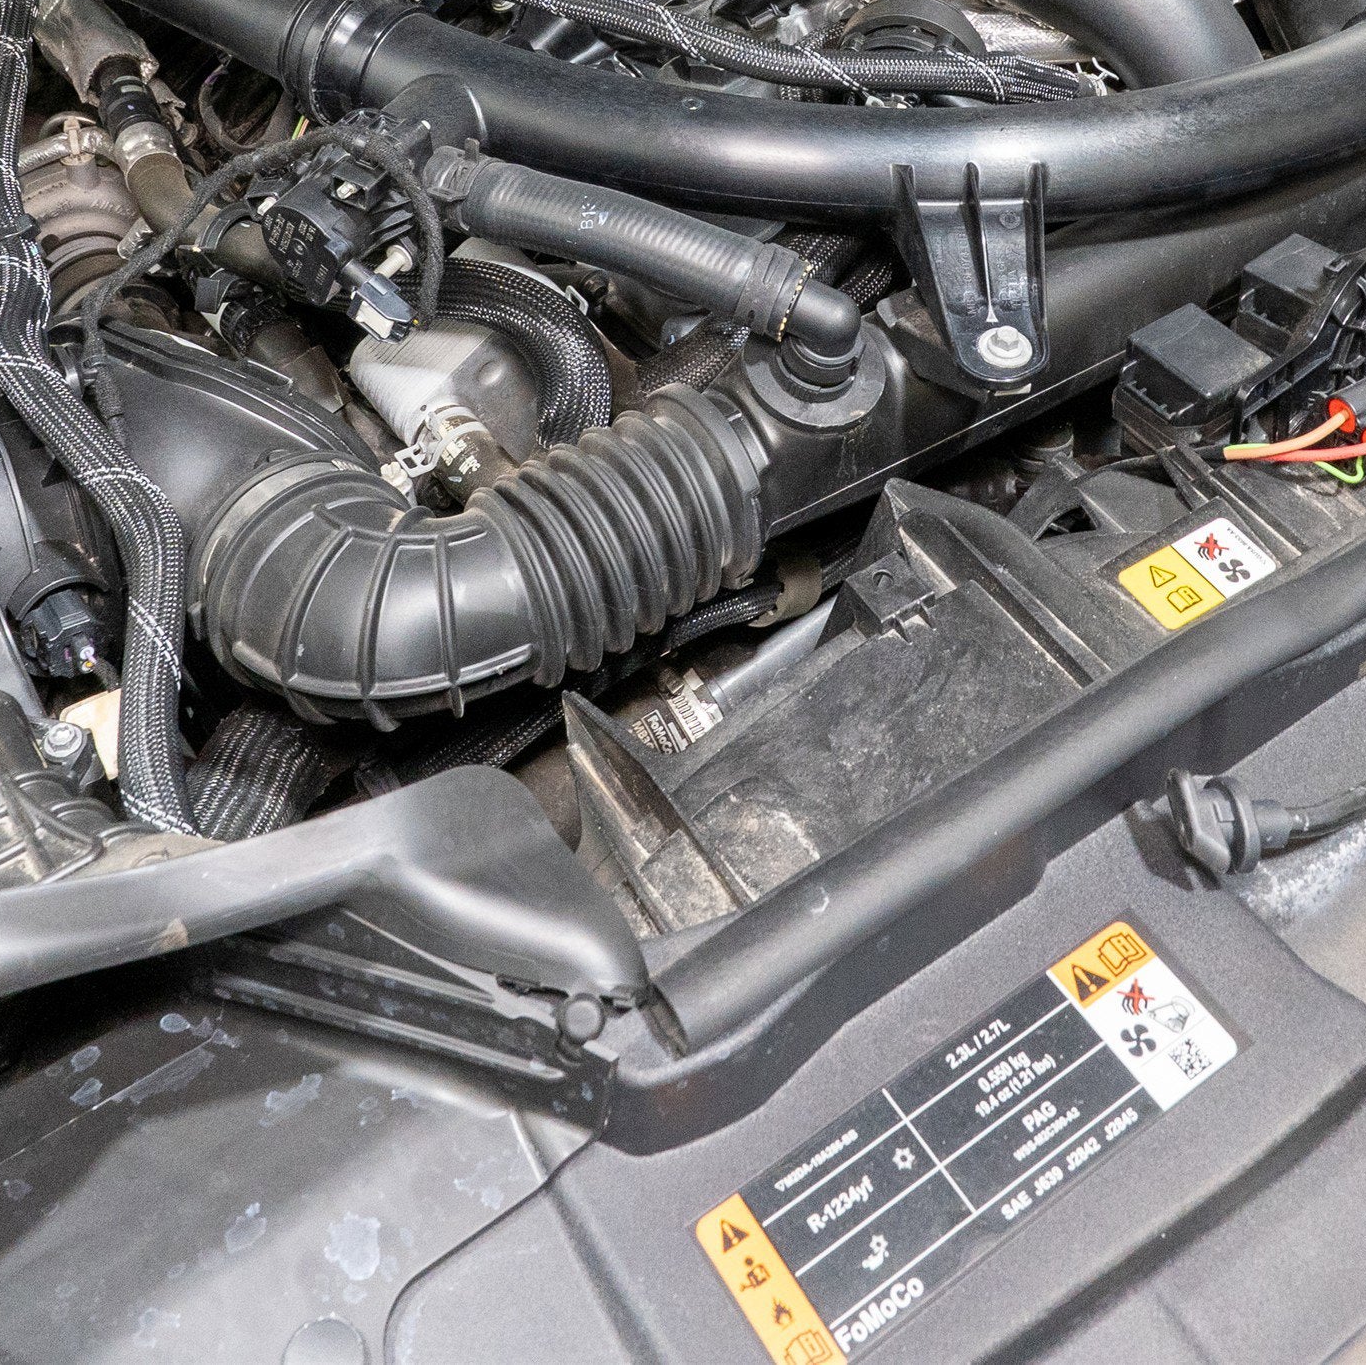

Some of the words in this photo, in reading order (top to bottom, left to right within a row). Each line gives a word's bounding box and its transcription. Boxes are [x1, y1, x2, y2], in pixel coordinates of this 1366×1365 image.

[648, 715, 674, 753] FoMoCo
[946, 1043, 977, 1069] 2.3L
[973, 1035, 982, 1049] /
[980, 1019, 1010, 1044] 2.7L
[978, 1060, 1012, 1092] 0.550
[1008, 1052, 1030, 1074] kg
[975, 1095, 999, 1117] 19.4
[997, 1087, 1013, 1102] oz
[1022, 1101, 1056, 1132] PAG
[1001, 1191, 1032, 1220] SAE
[1034, 1166, 1063, 1196] J639
[1066, 1137, 1101, 1171] J2842
[1105, 1107, 1138, 1141] J2845
[807, 1175, 873, 1233] R-1234yf
[833, 1278, 925, 1353] FoMoCo
